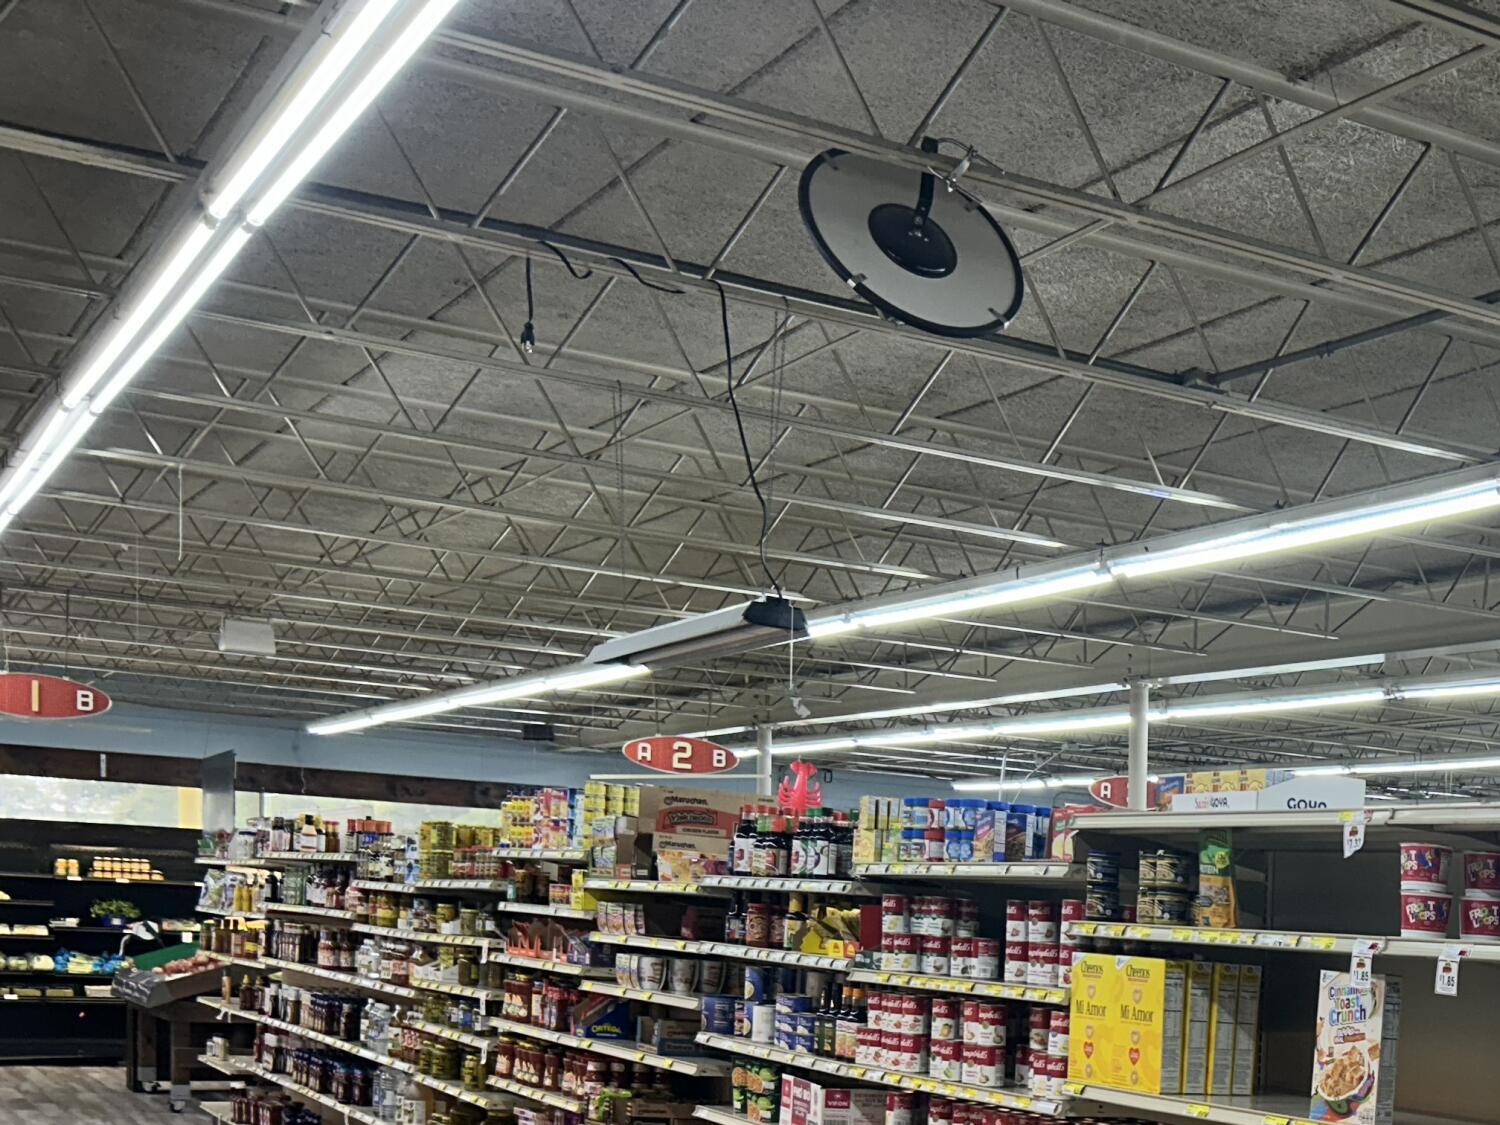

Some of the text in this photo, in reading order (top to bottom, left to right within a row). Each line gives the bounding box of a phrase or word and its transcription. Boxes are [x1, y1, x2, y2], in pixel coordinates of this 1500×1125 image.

[76, 689, 94, 712] B
[637, 741, 727, 770] A 2 B
[1101, 782, 1111, 800] A
[1076, 1000, 1107, 1017] Mi Amor
[1120, 1004, 1154, 1022] Mi Amor
[1329, 1005, 1367, 1026] Crunch
